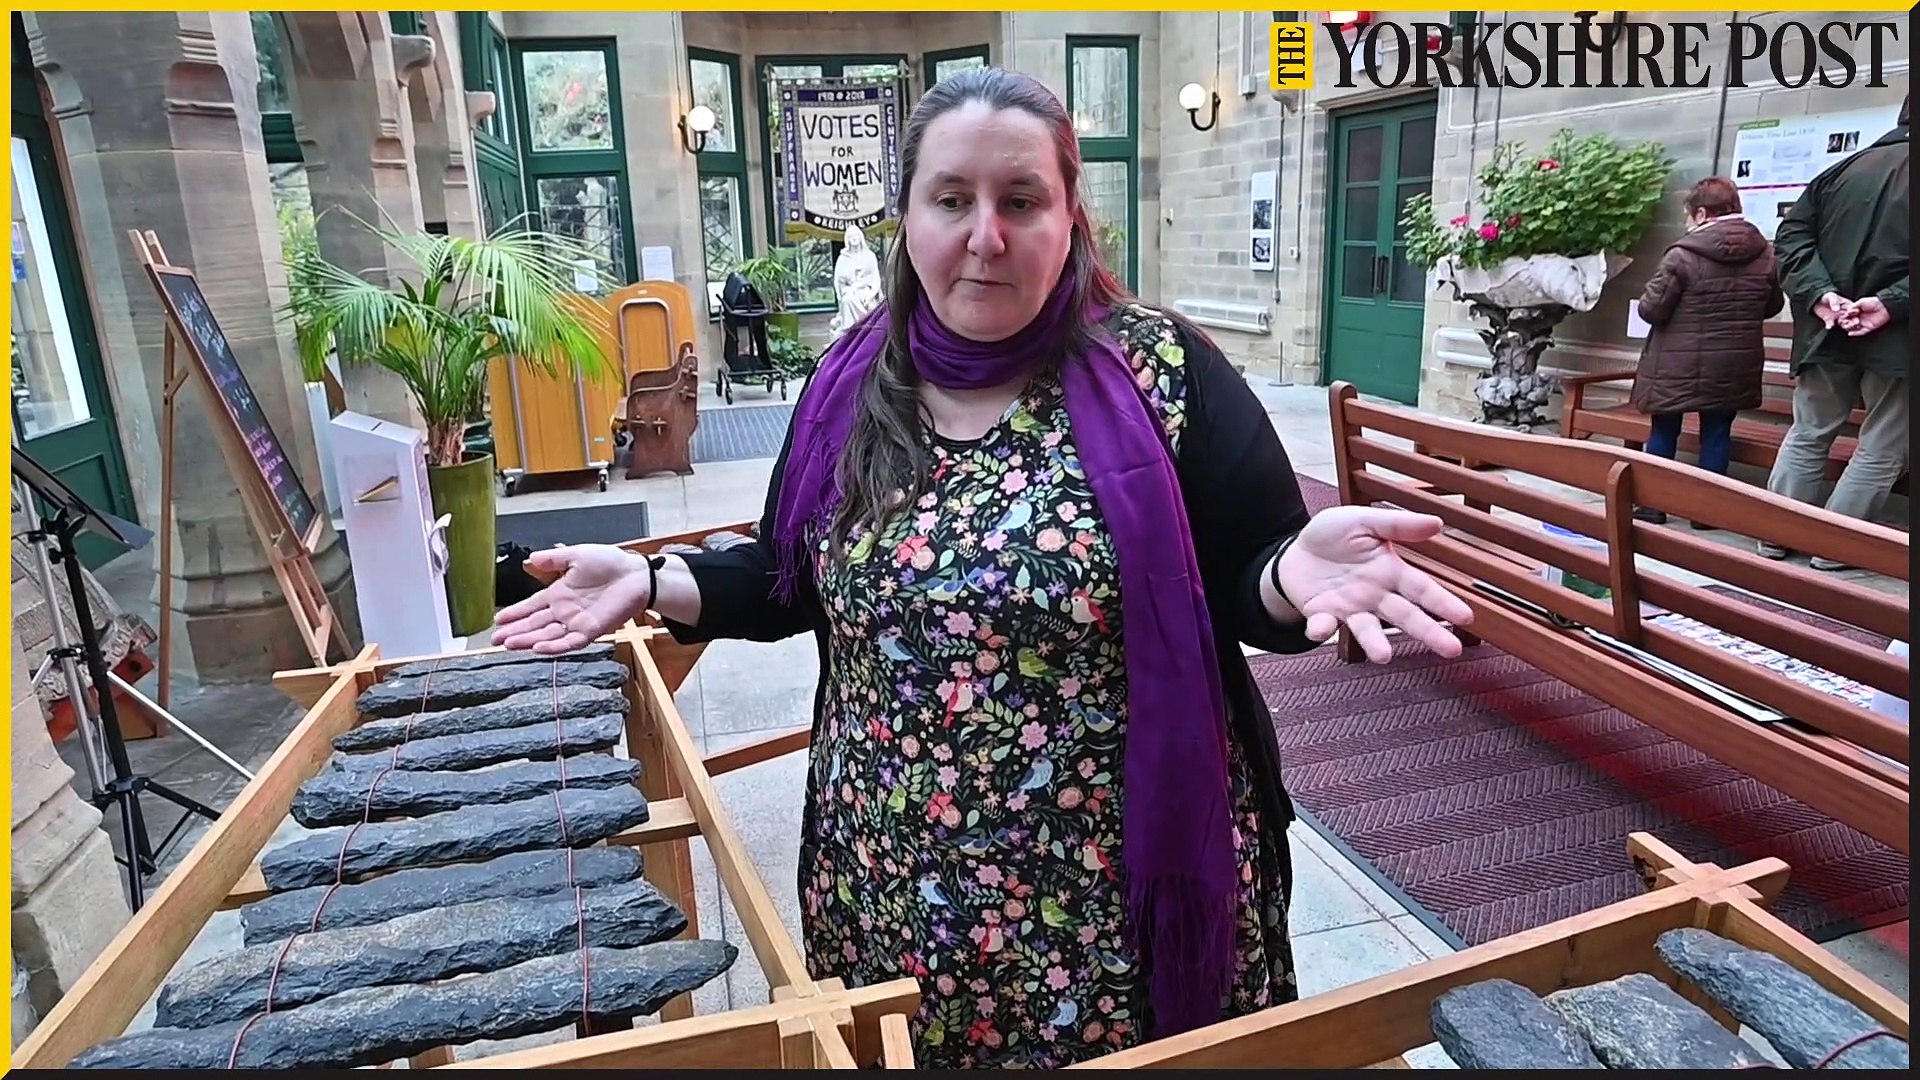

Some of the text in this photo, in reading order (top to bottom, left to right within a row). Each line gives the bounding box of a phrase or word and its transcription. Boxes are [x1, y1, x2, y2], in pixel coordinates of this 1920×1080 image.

[845, 90, 866, 100] 2018
[802, 114, 879, 139] VOTES
[785, 111, 797, 193] SUFFRAGE
[831, 146, 855, 157] FOR
[886, 106, 898, 194] CENTENARY
[804, 160, 882, 187] WOMEN
